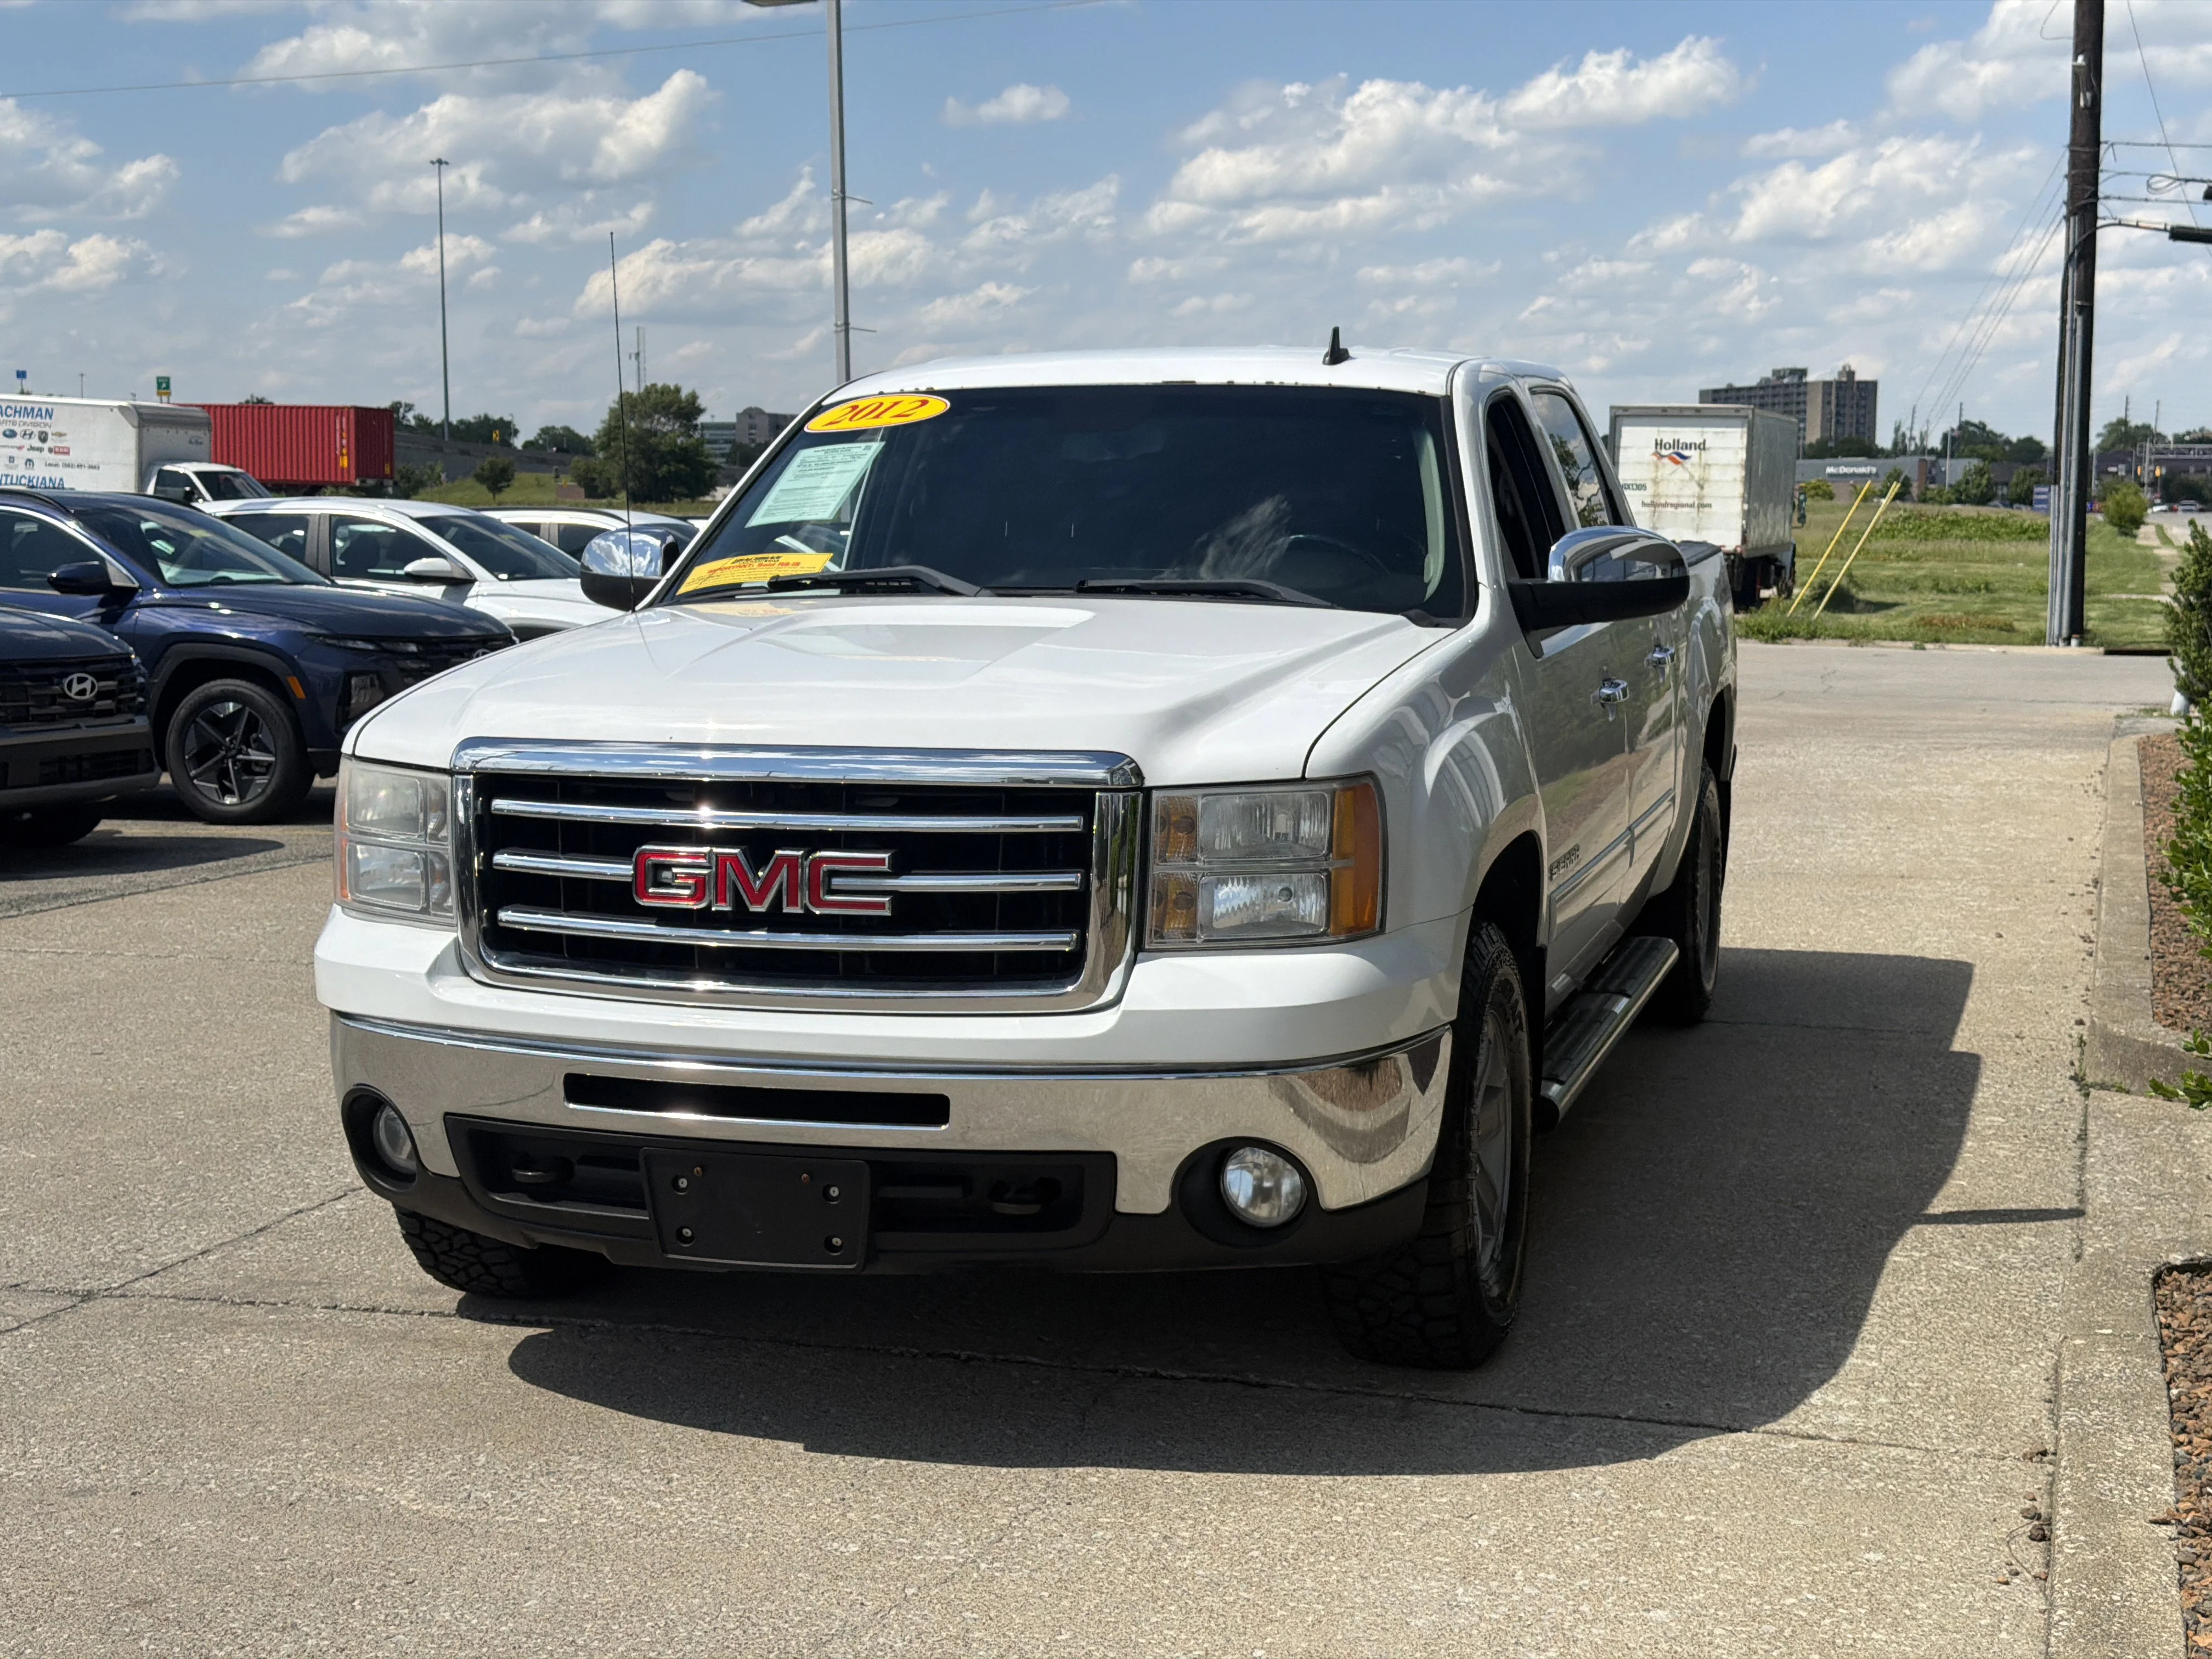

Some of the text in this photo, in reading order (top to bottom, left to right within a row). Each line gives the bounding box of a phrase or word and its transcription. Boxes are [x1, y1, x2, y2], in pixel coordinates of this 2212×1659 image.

[821, 399, 929, 427] 2012
[1655, 438, 1706, 450] Holland
[1826, 466, 1876, 474] McDonald's
[632, 843, 893, 916] GMC
